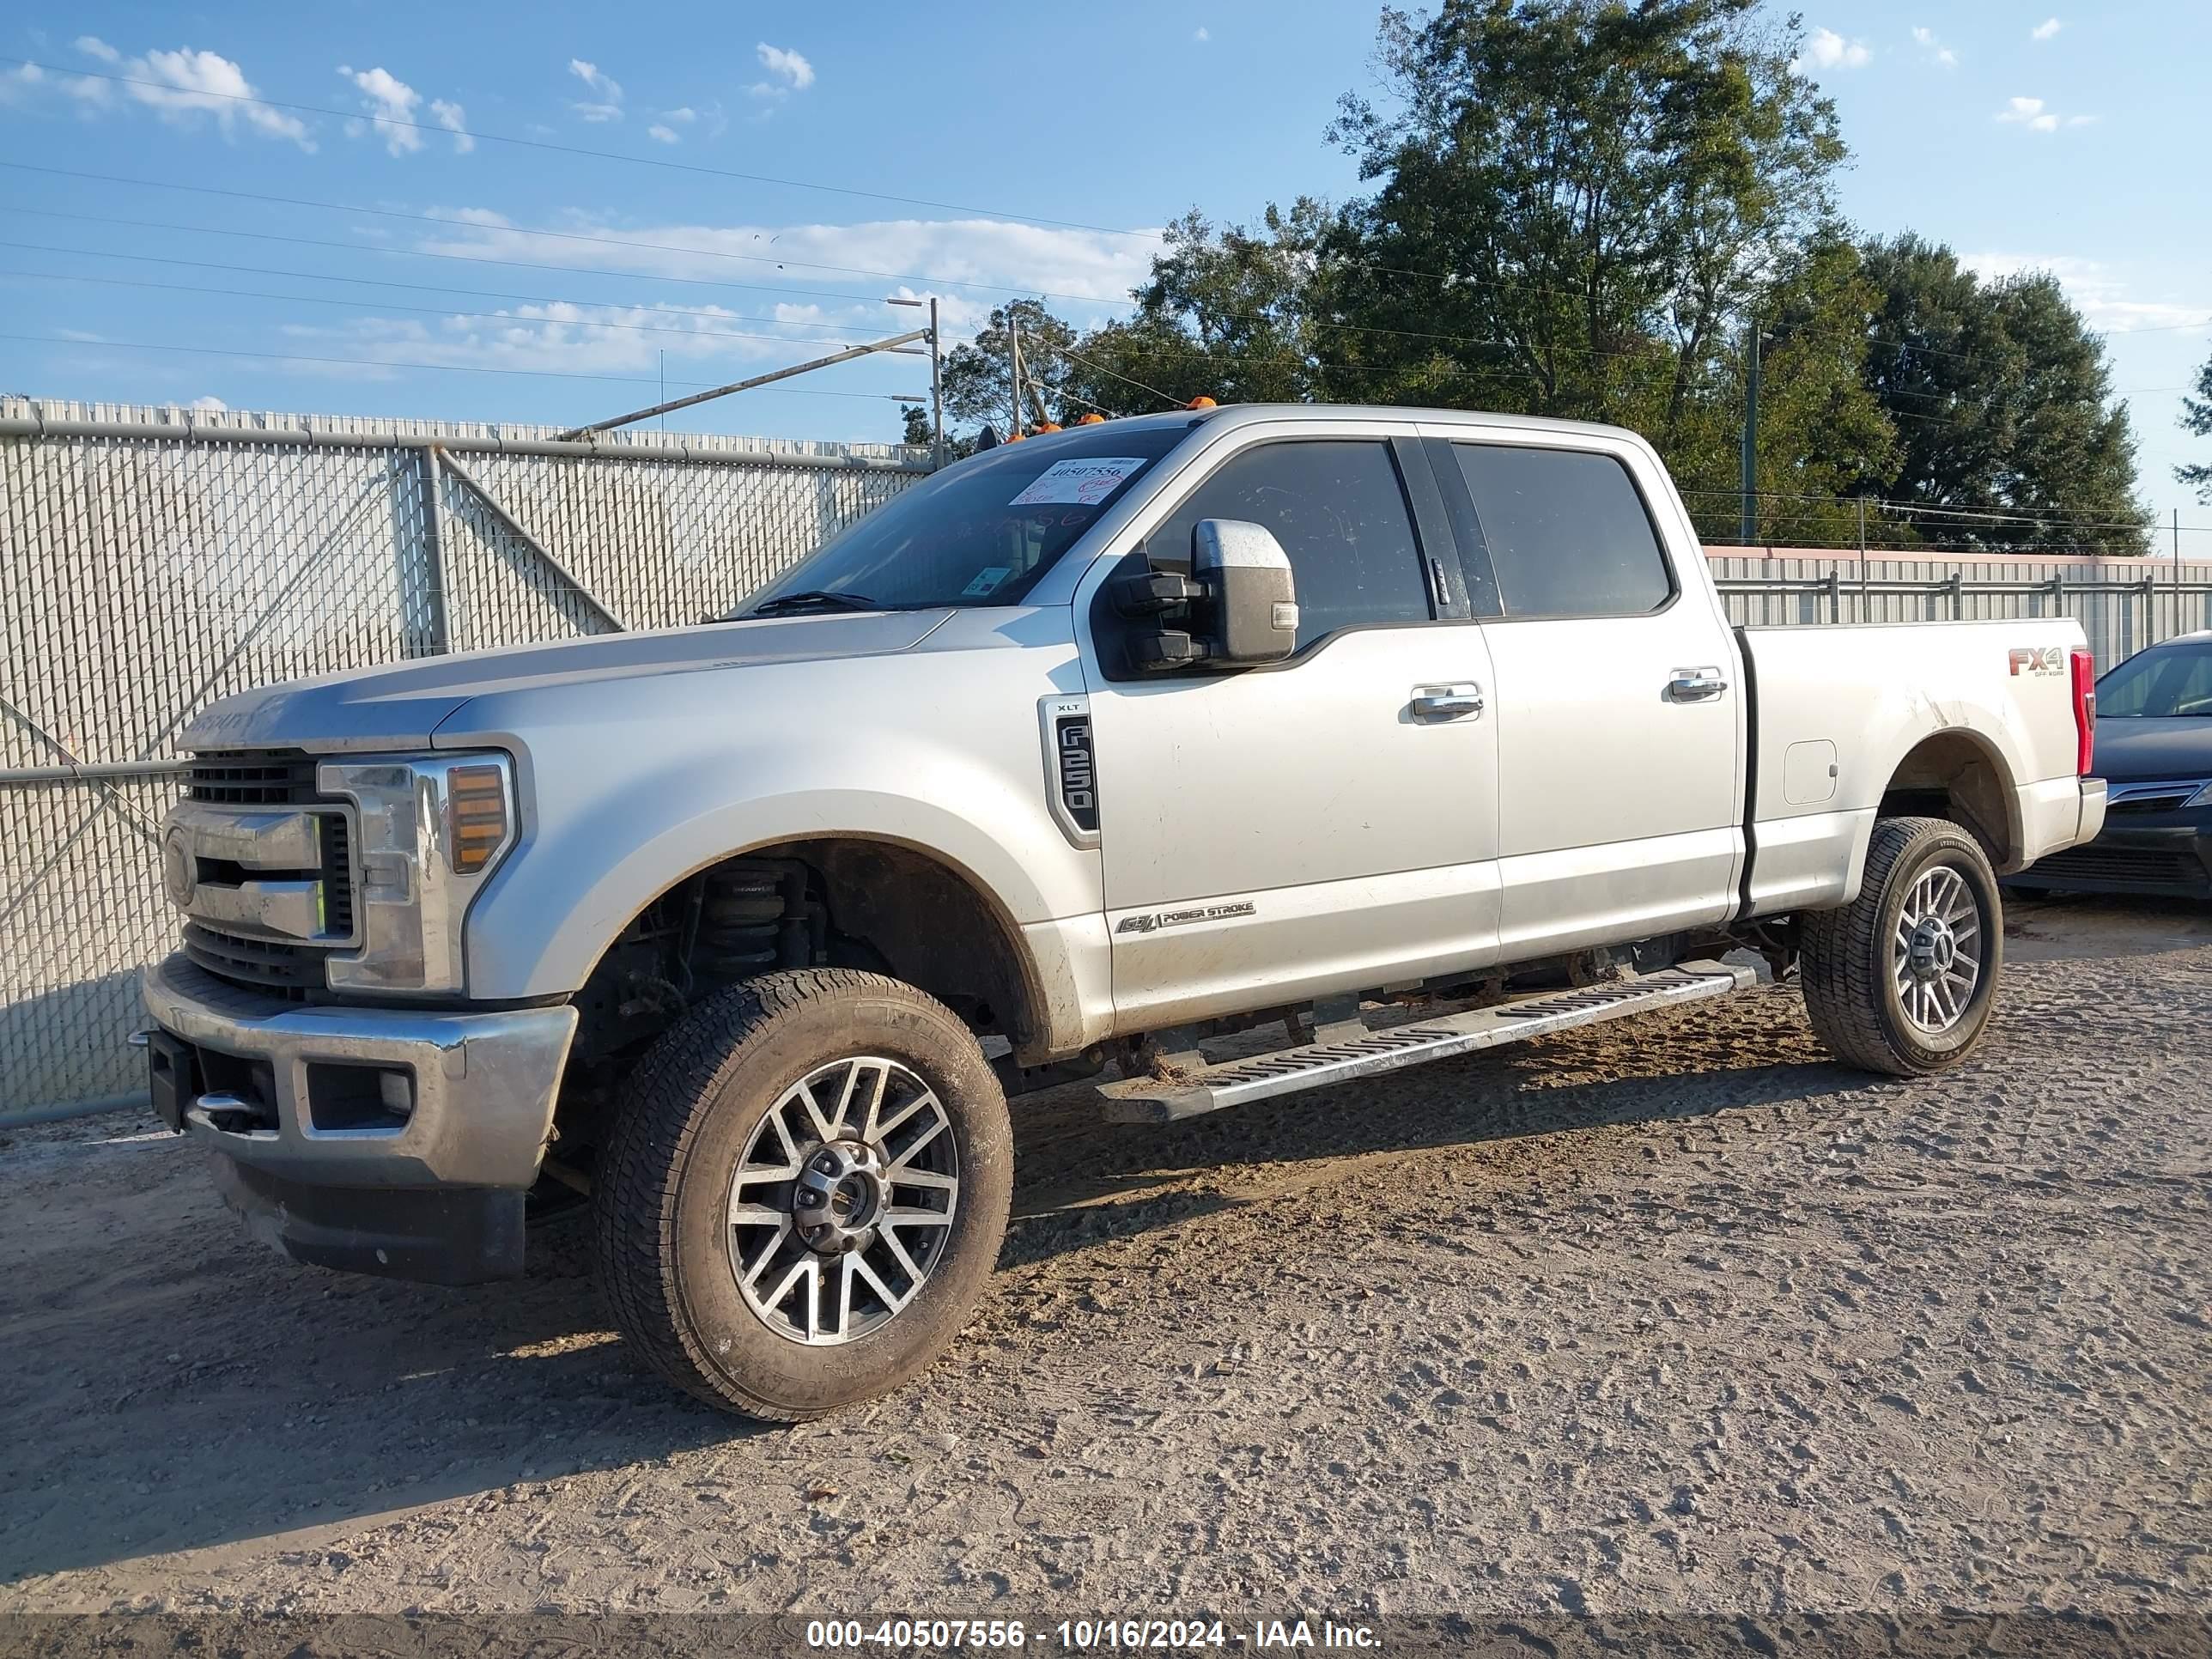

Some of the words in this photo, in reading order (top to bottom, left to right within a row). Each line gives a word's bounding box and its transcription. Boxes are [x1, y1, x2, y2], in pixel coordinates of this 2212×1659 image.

[2008, 647, 2063, 676] FX4
[1062, 725, 1093, 809] F250
[1164, 909, 1205, 922] POWER
[1206, 902, 1254, 916] STROKE
